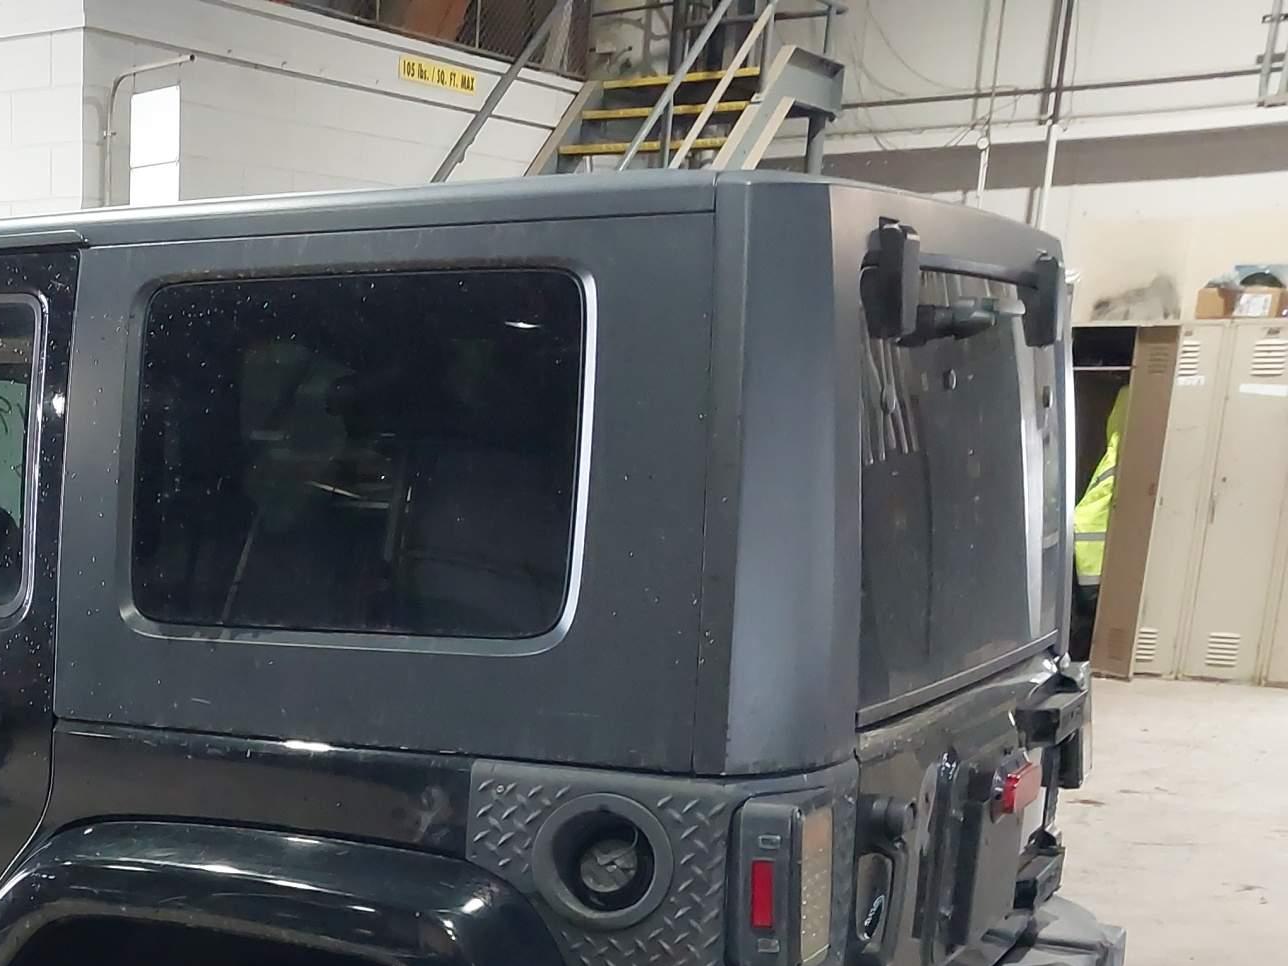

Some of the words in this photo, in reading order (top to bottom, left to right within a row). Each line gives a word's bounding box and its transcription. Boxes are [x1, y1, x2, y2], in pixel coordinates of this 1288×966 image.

[403, 60, 415, 77] 105
[417, 63, 429, 81] lbs.
[437, 68, 447, 86] SQ.
[449, 71, 458, 89] FT.
[460, 74, 475, 91] MAX
